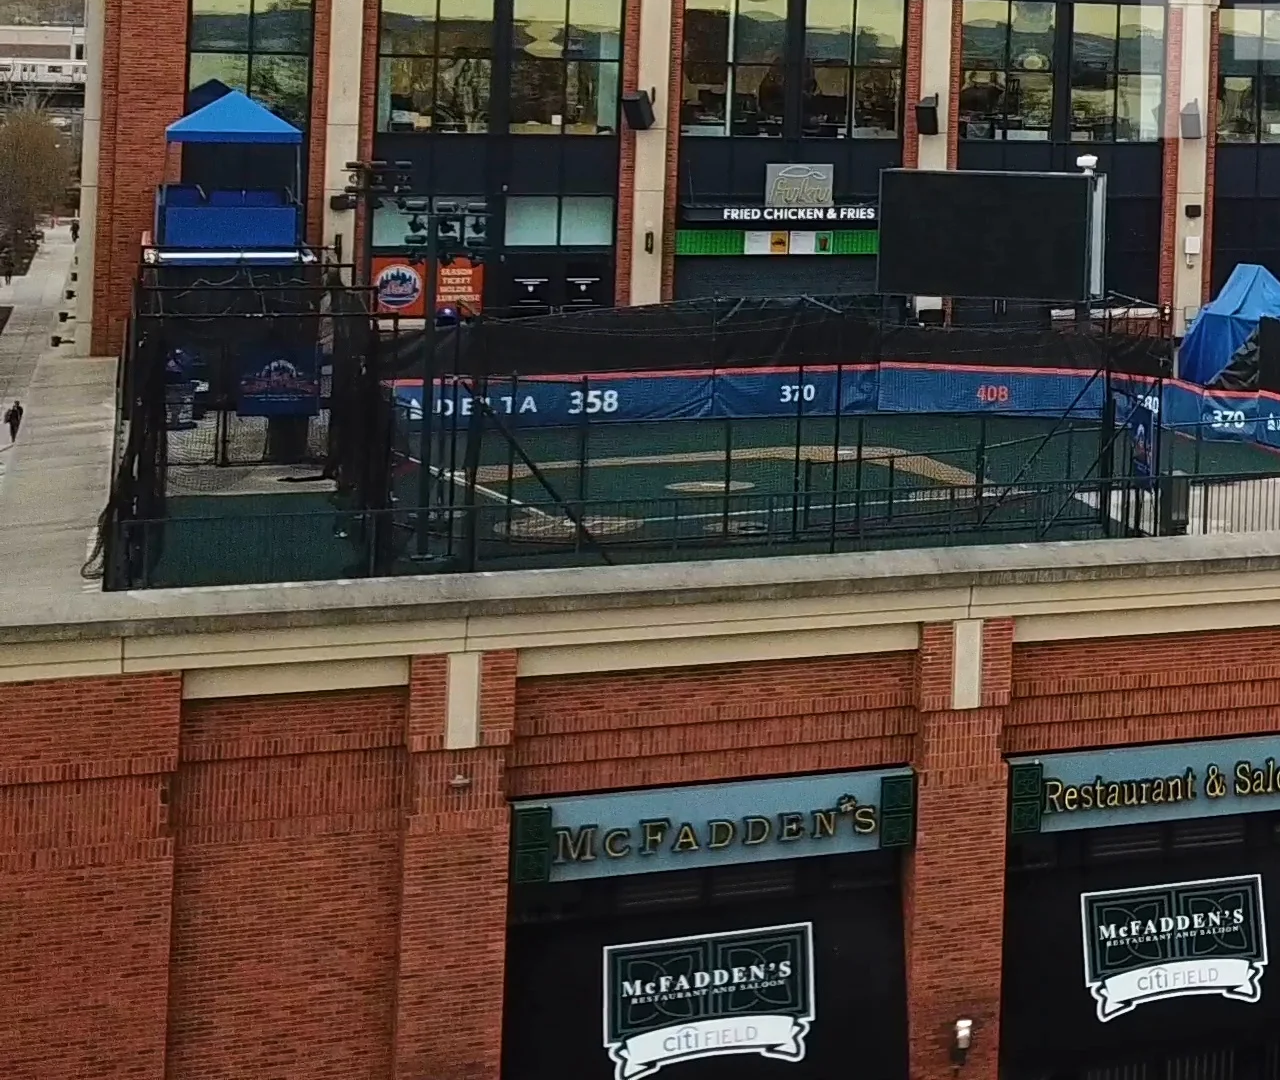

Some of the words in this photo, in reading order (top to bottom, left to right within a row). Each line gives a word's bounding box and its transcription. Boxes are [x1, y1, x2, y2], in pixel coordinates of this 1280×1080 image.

[724, 209, 761, 219] FRIED
[764, 208, 824, 219] CHICKEN
[826, 208, 837, 219] &
[840, 208, 875, 219] FRIES
[568, 390, 618, 414] 358
[780, 384, 815, 402] 370
[976, 385, 1008, 402] 408
[1212, 410, 1245, 428] 370
[1044, 770, 1196, 813] Restaurant
[1206, 765, 1226, 798] &
[1106, 933, 1172, 947] RESTAURANT
[1200, 925, 1239, 935] SALOON
[1137, 970, 1168, 991] citi
[1173, 968, 1218, 986] FIELD
[631, 990, 707, 1004] RESTAURANT
[740, 979, 785, 990] SALOON
[663, 1028, 698, 1051] citi
[705, 1026, 757, 1046] FIELD
